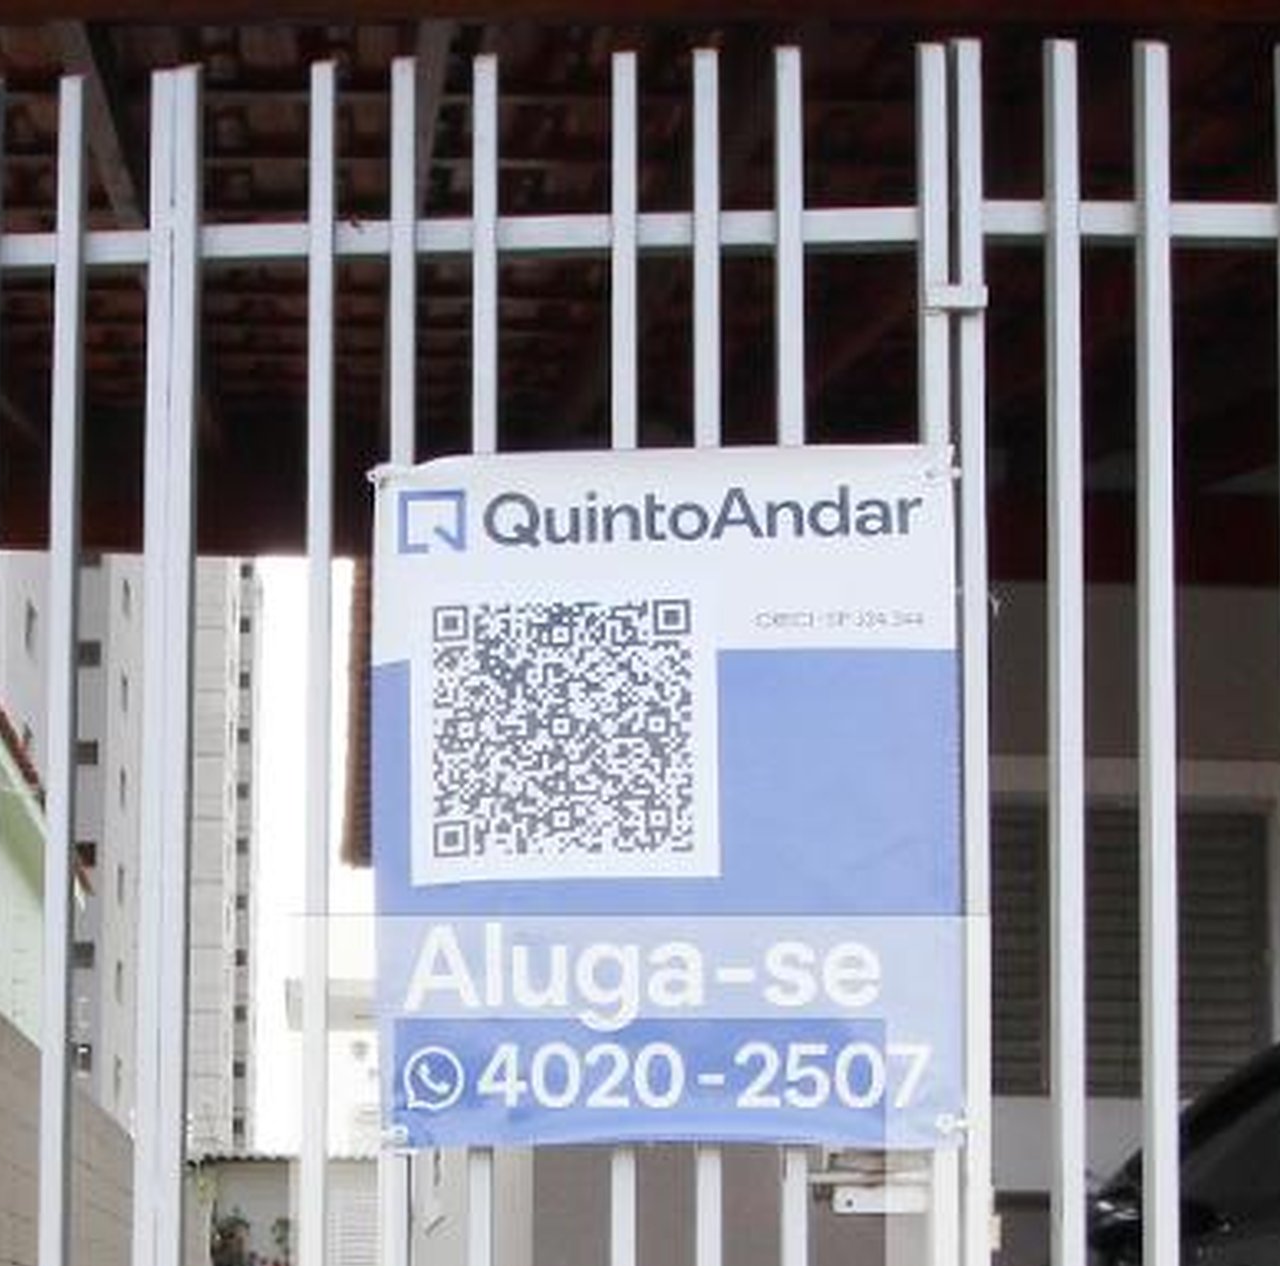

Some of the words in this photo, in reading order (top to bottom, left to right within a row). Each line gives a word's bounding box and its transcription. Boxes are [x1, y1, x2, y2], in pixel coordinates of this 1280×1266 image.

[482, 485, 924, 548] QuintoAndar
[402, 921, 883, 1032] Aluga-se
[476, 1040, 934, 1110] 4020-2507
